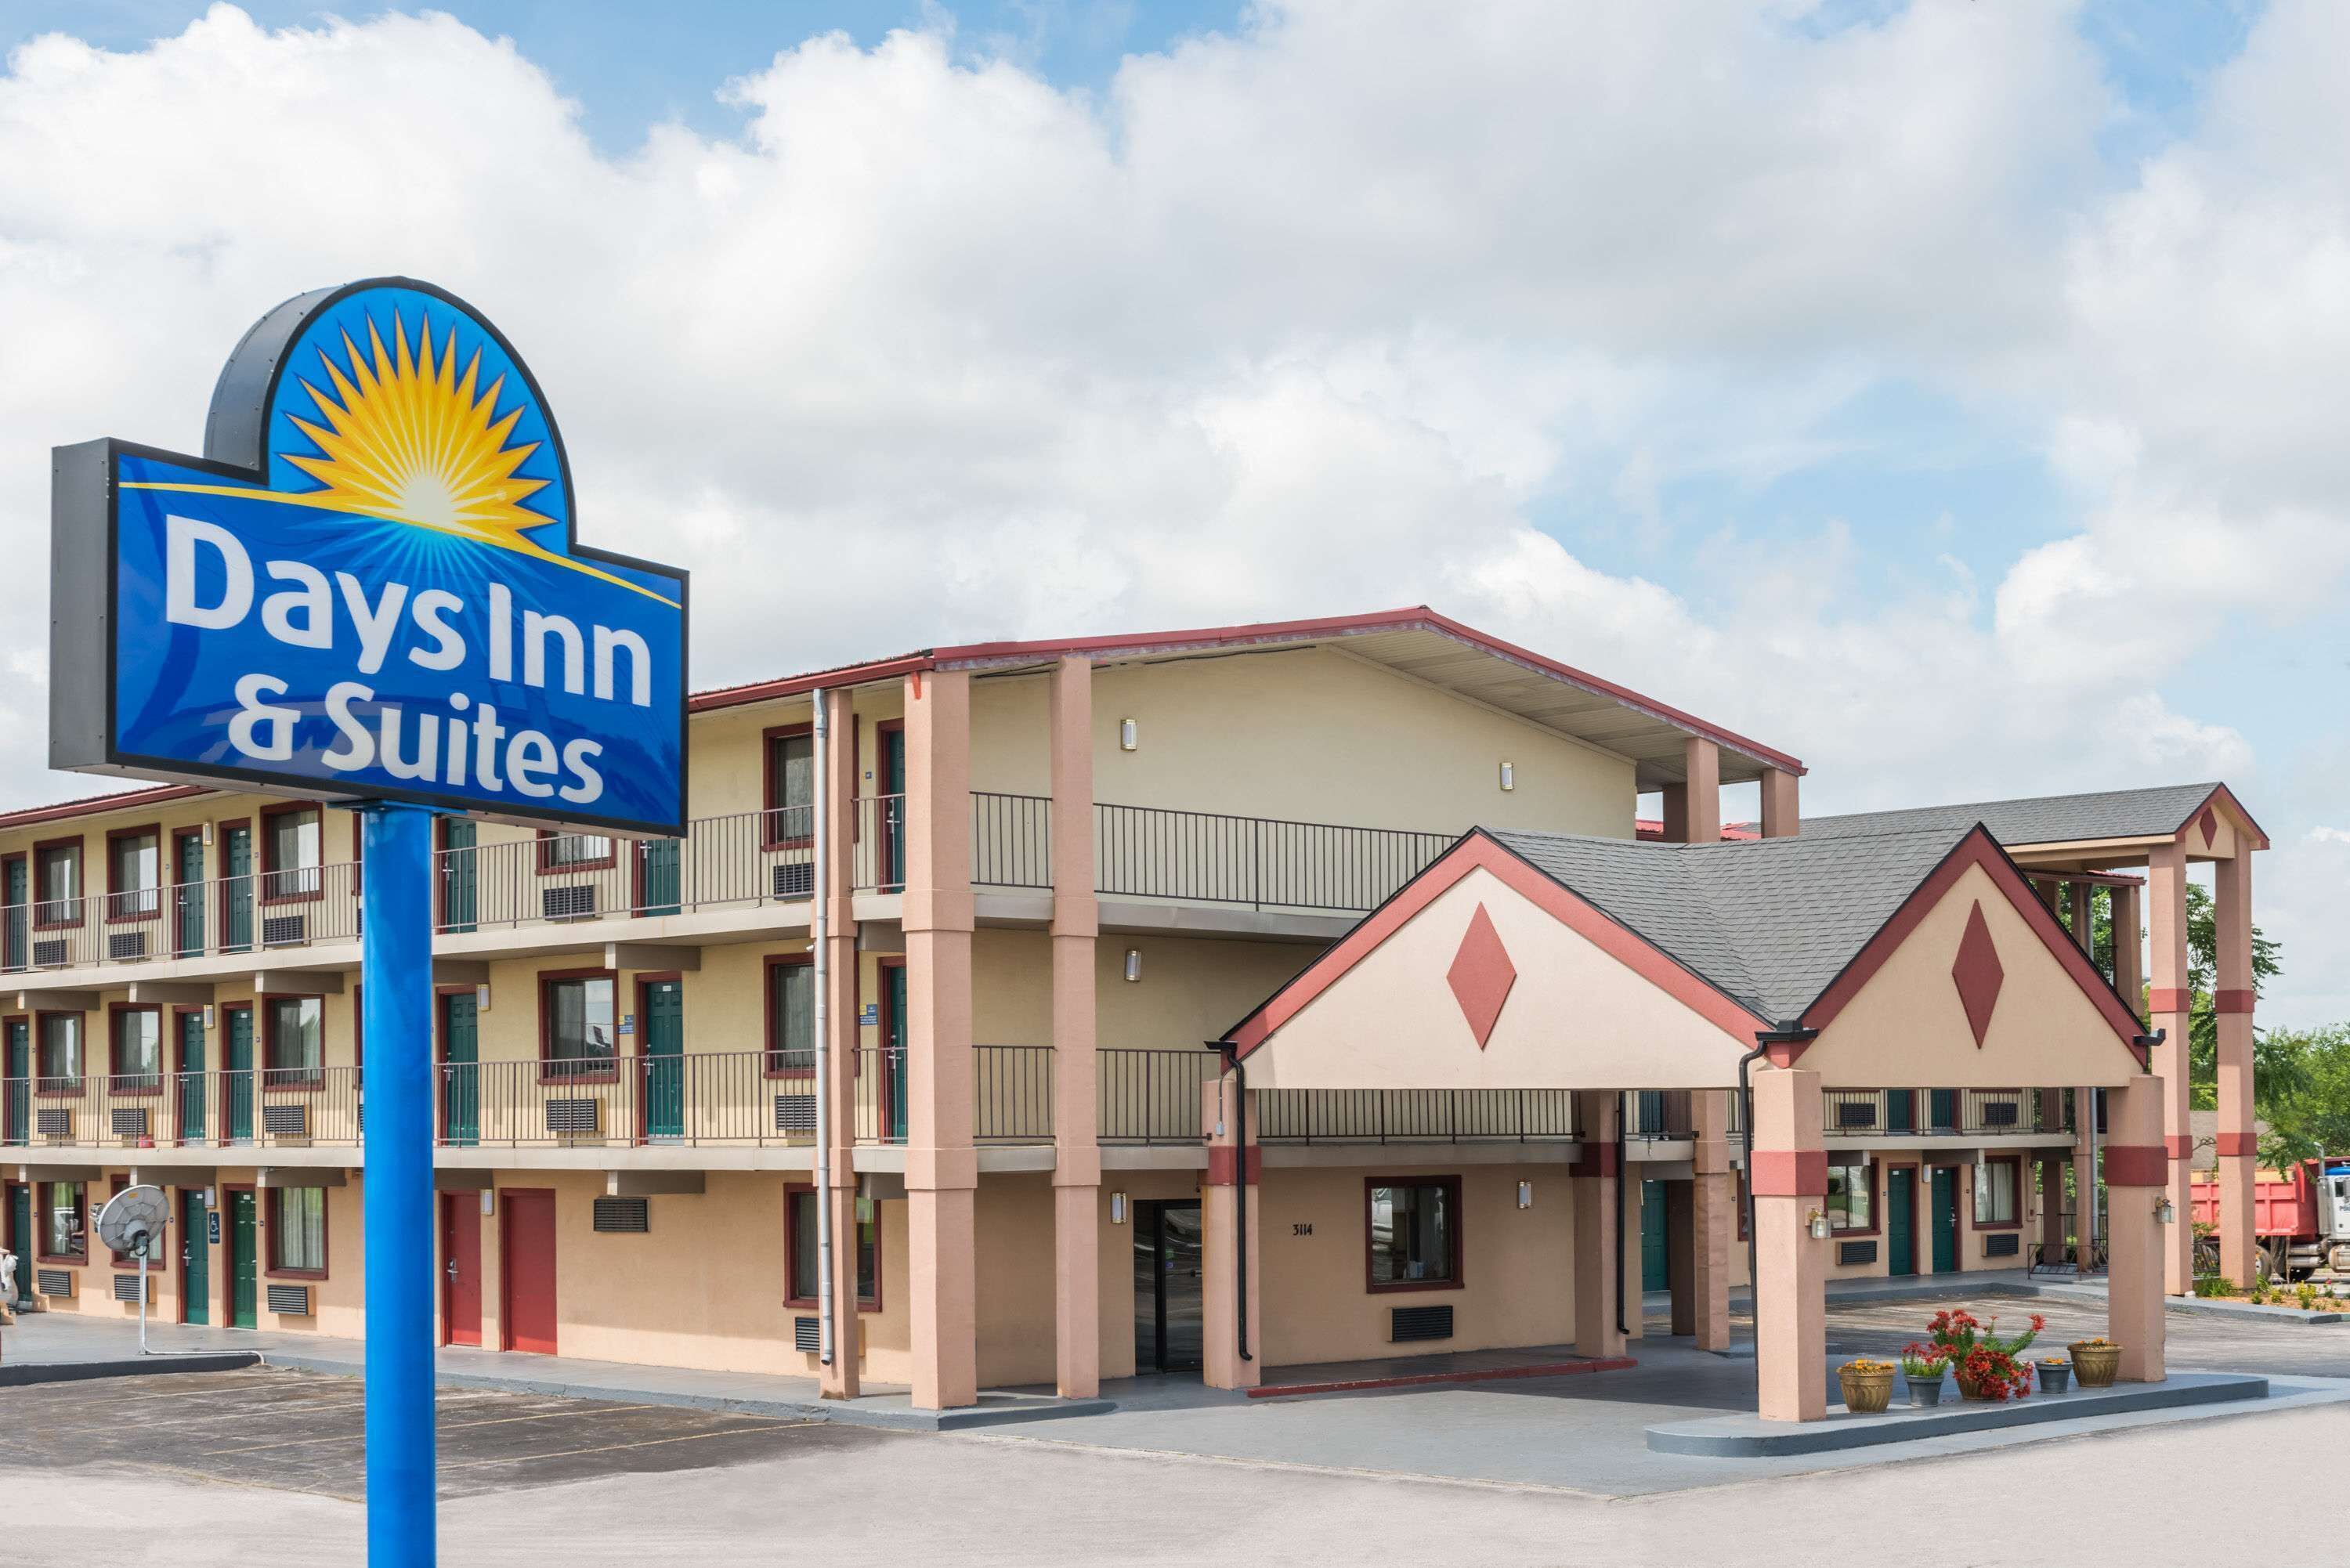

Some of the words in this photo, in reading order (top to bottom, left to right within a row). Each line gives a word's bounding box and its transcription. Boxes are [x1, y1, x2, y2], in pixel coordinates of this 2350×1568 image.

[166, 514, 467, 674] Days
[489, 583, 651, 707] Inn
[227, 674, 302, 761] &
[321, 682, 603, 804] Suites
[1292, 1223, 1313, 1236] 3114
